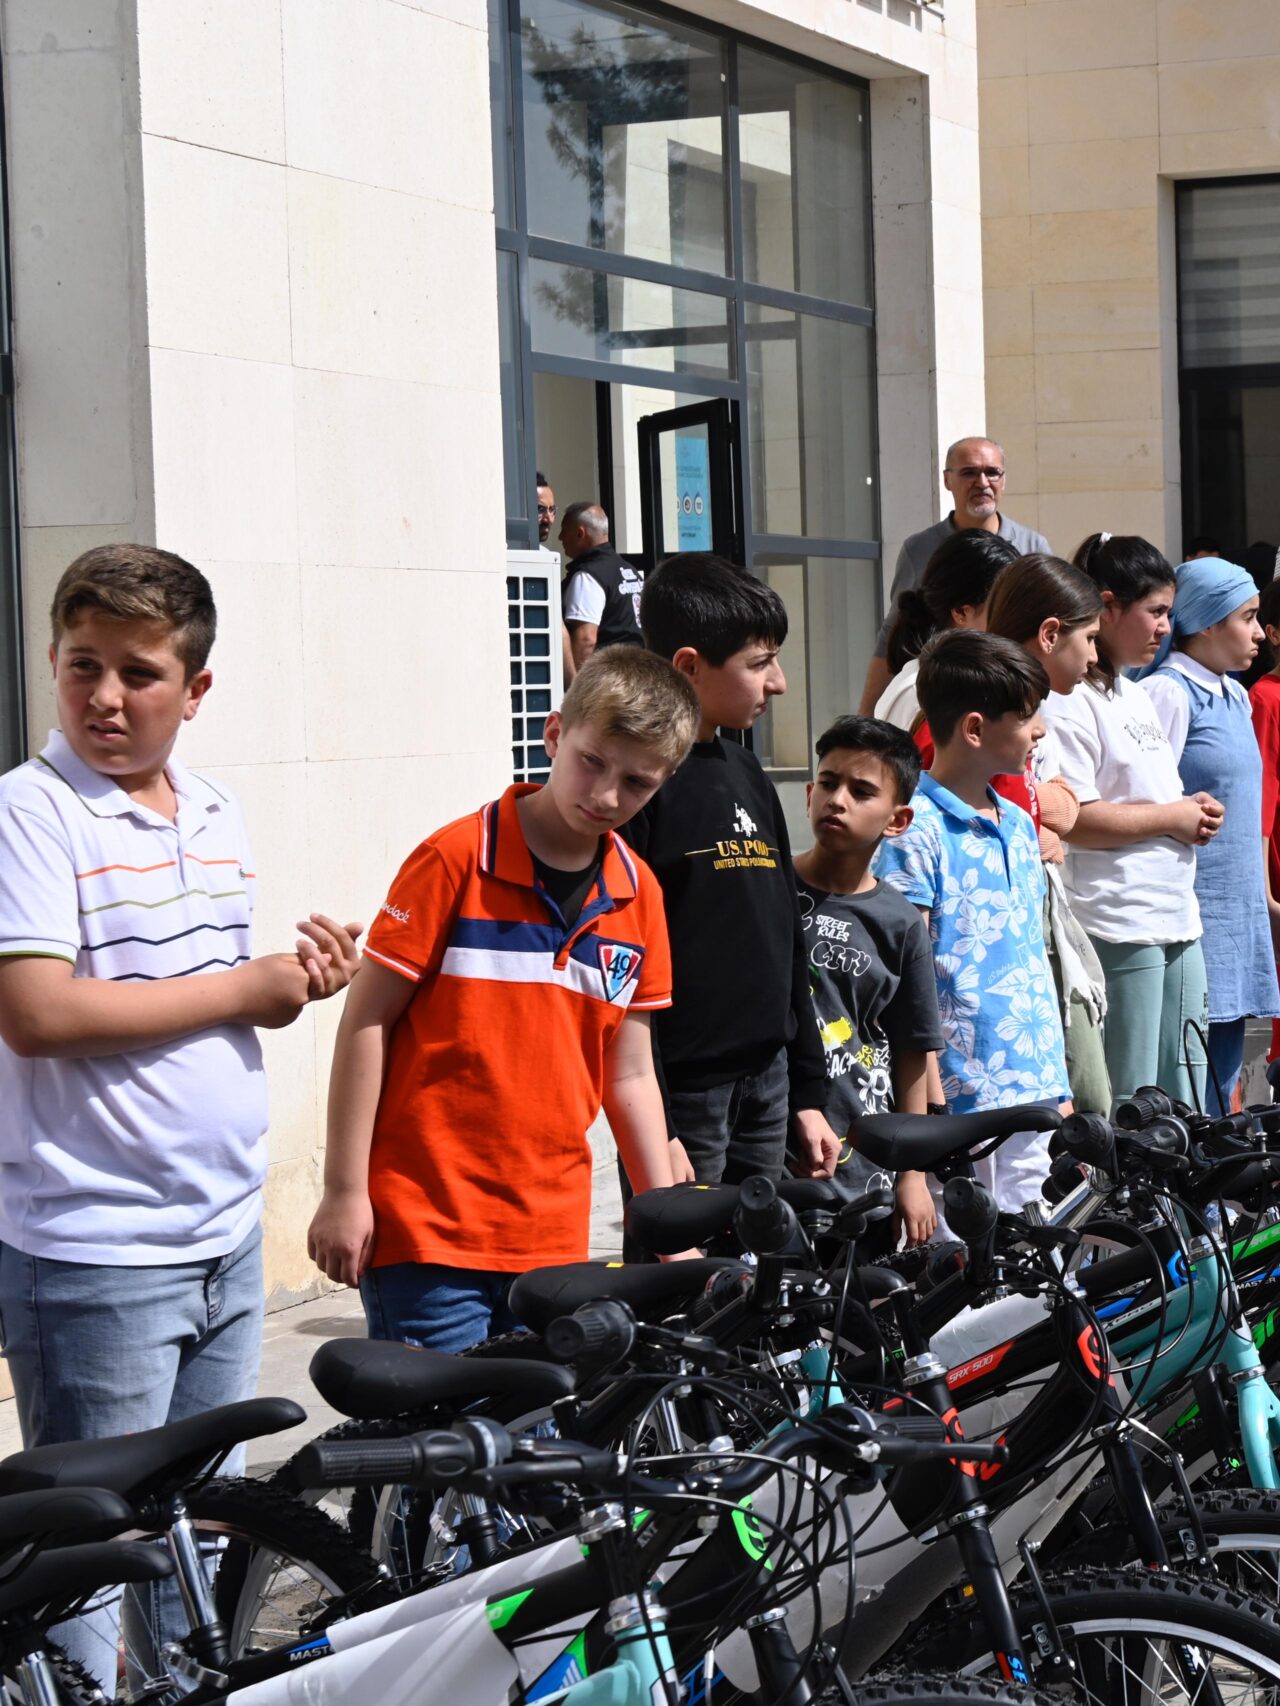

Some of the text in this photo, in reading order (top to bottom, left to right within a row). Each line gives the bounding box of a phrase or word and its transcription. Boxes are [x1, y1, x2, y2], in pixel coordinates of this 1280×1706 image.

[816, 914, 852, 932] STREET
[817, 926, 850, 942] RULES
[607, 952, 631, 980] 49
[811, 941, 872, 976] CITY
[949, 1354, 995, 1384] SRX 500
[289, 1645, 335, 1661] MAST
